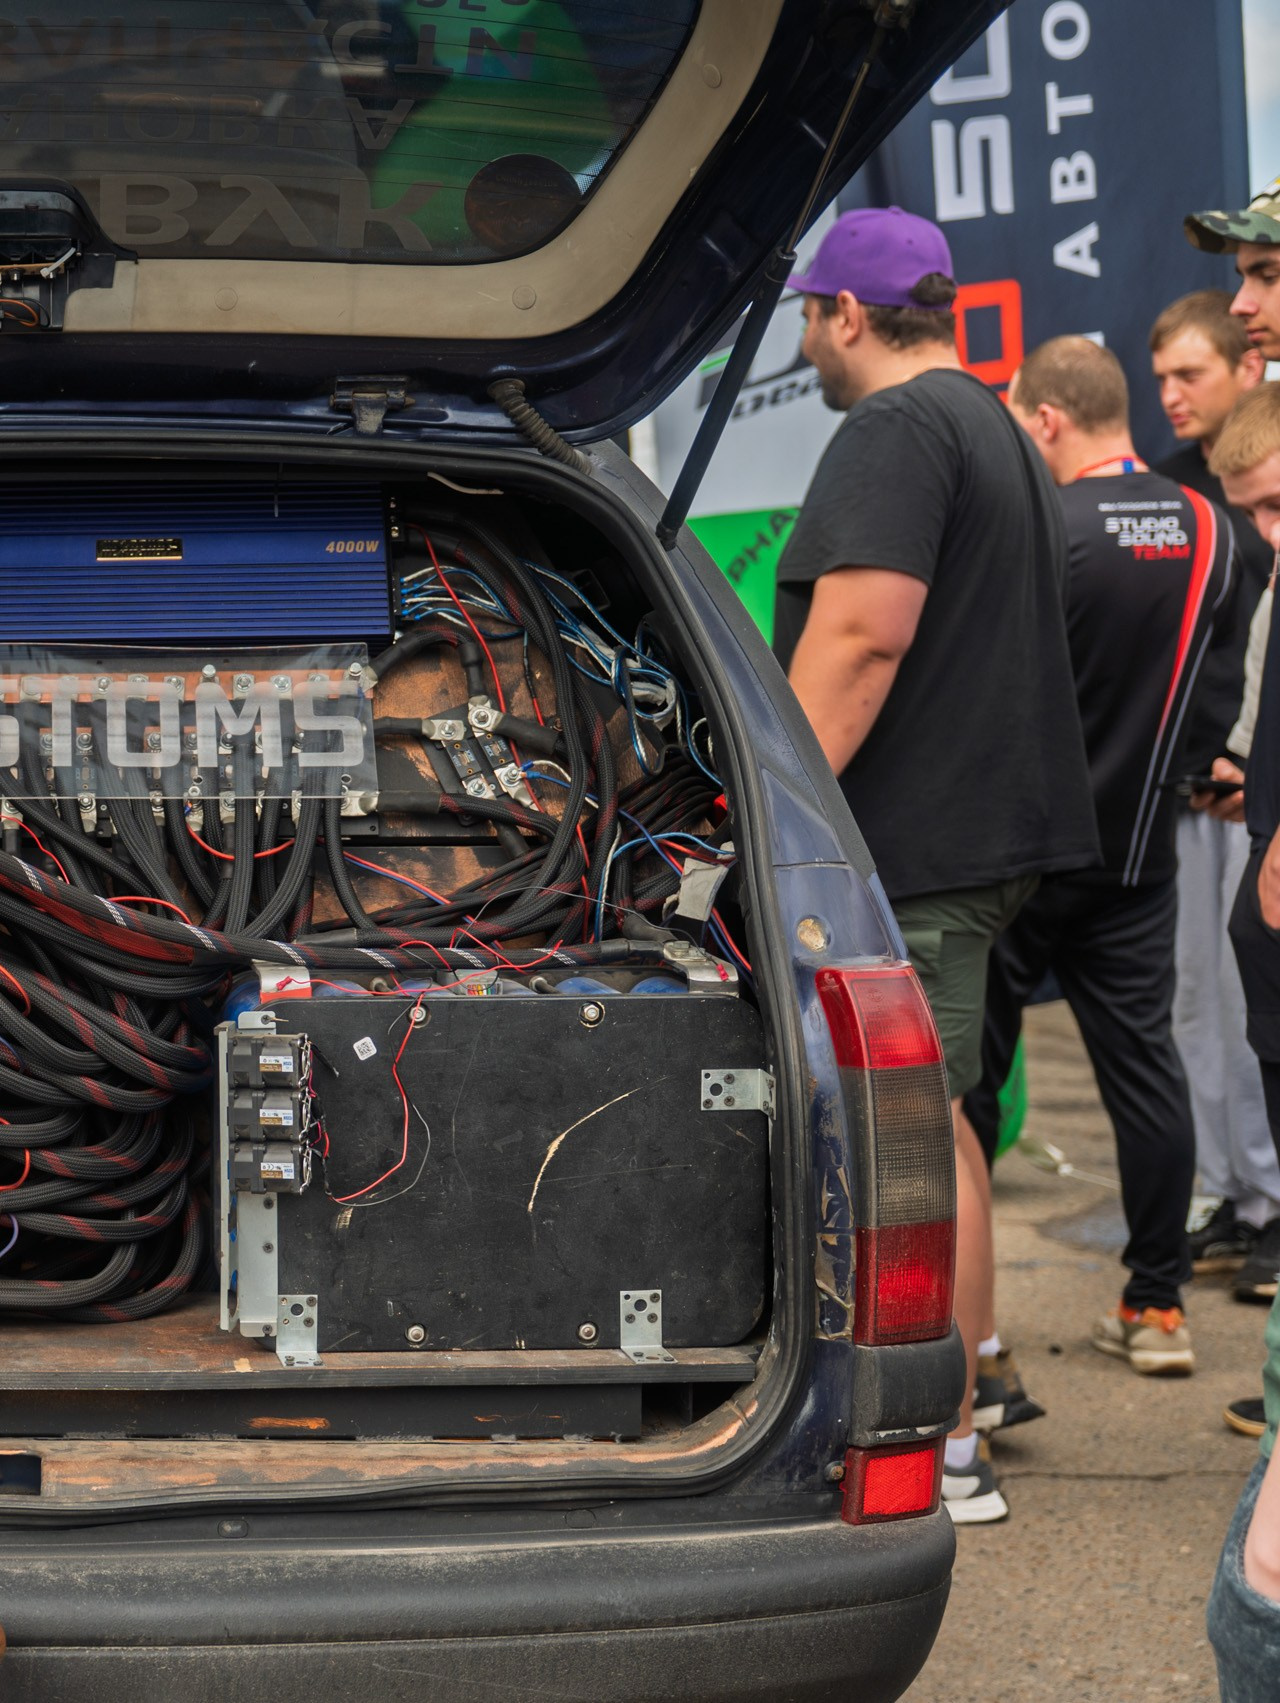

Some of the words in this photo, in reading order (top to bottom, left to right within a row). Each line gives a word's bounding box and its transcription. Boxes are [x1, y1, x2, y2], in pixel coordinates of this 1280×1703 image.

[1105, 516, 1179, 533] STUDIO
[325, 540, 380, 554] 4000W
[1118, 530, 1188, 547] SOUND
[1133, 543, 1191, 560] TEAM
